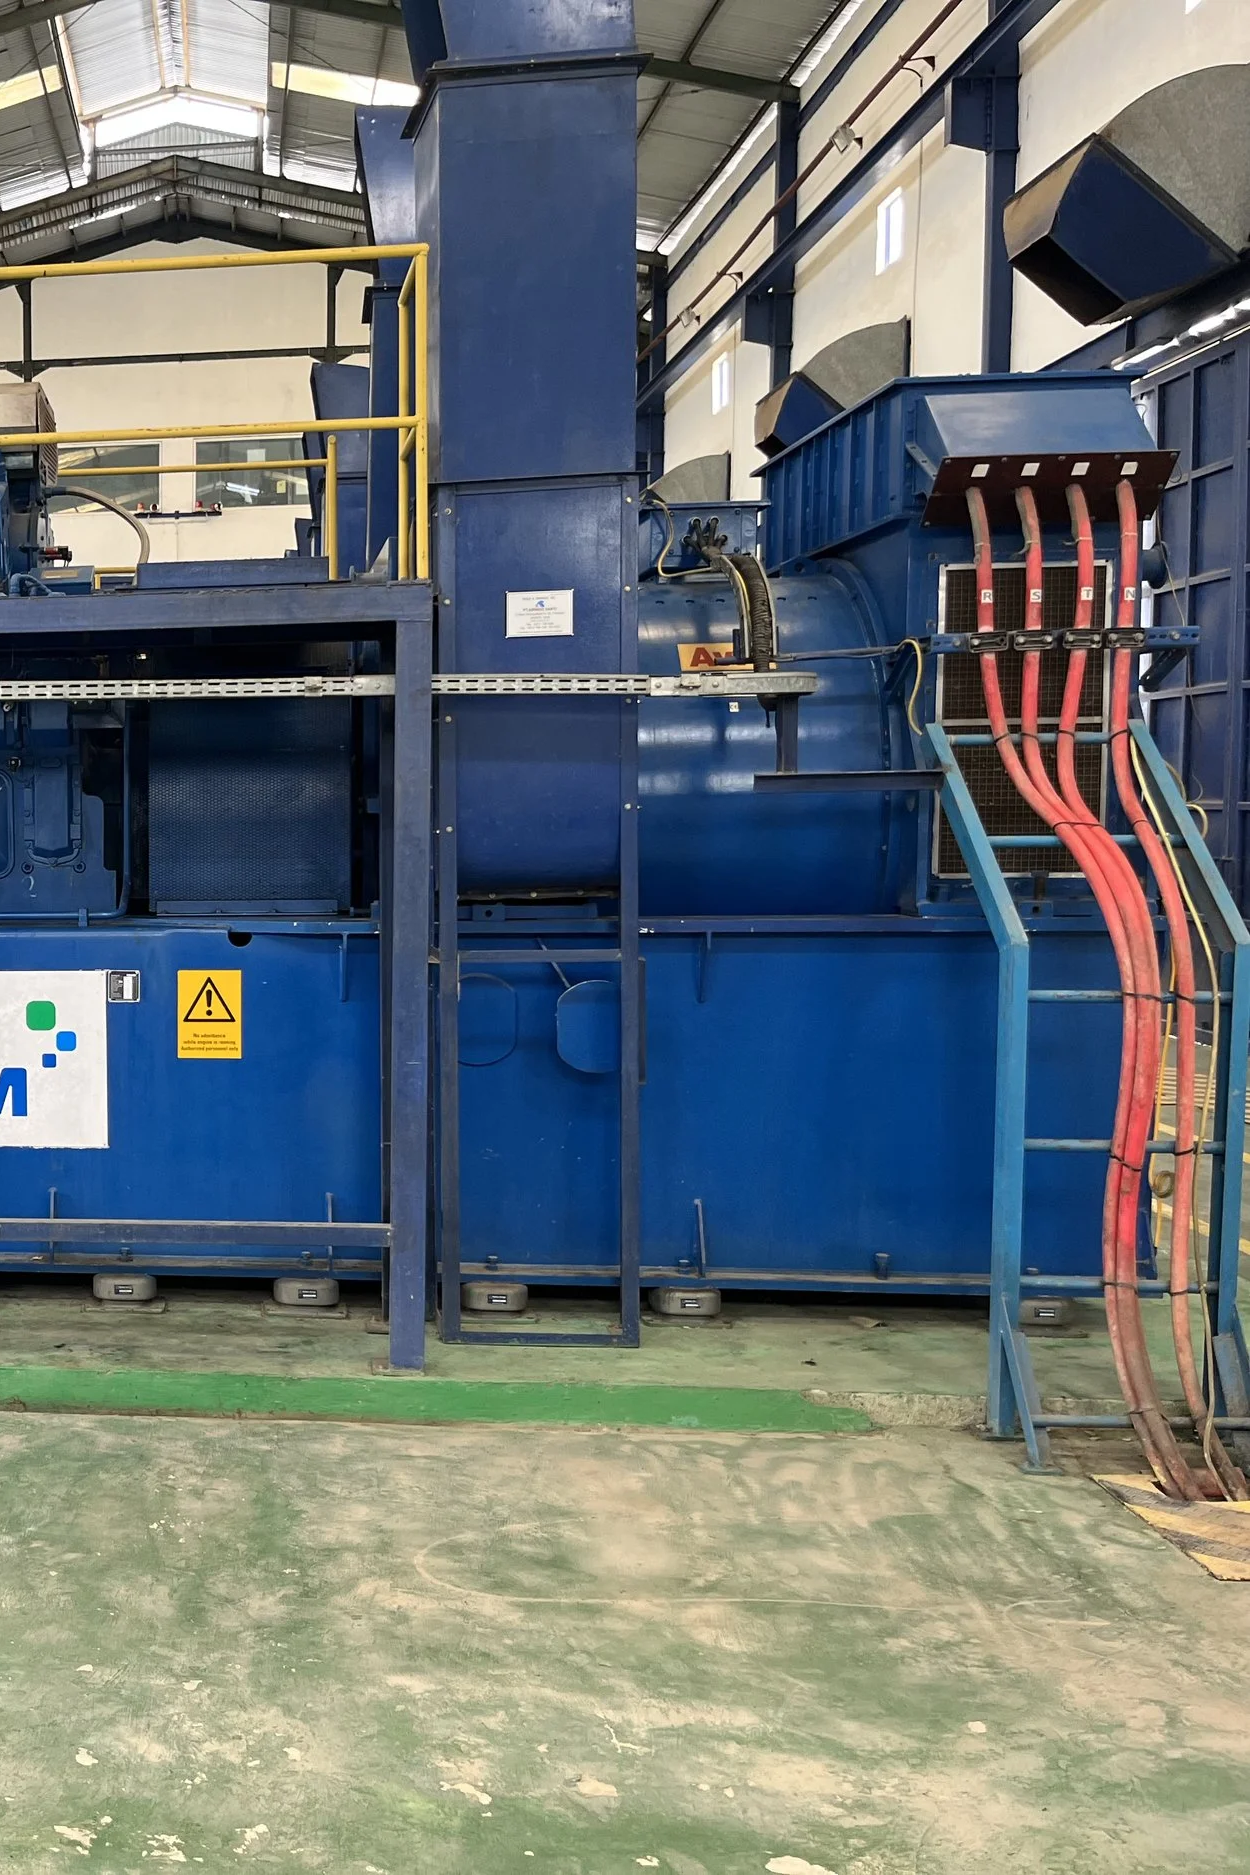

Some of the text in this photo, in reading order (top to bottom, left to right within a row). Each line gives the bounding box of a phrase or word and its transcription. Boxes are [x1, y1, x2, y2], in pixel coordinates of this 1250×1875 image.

[983, 591, 992, 600] R
[1031, 591, 1041, 600] S
[1084, 589, 1092, 598] T
[1126, 589, 1135, 598] N
